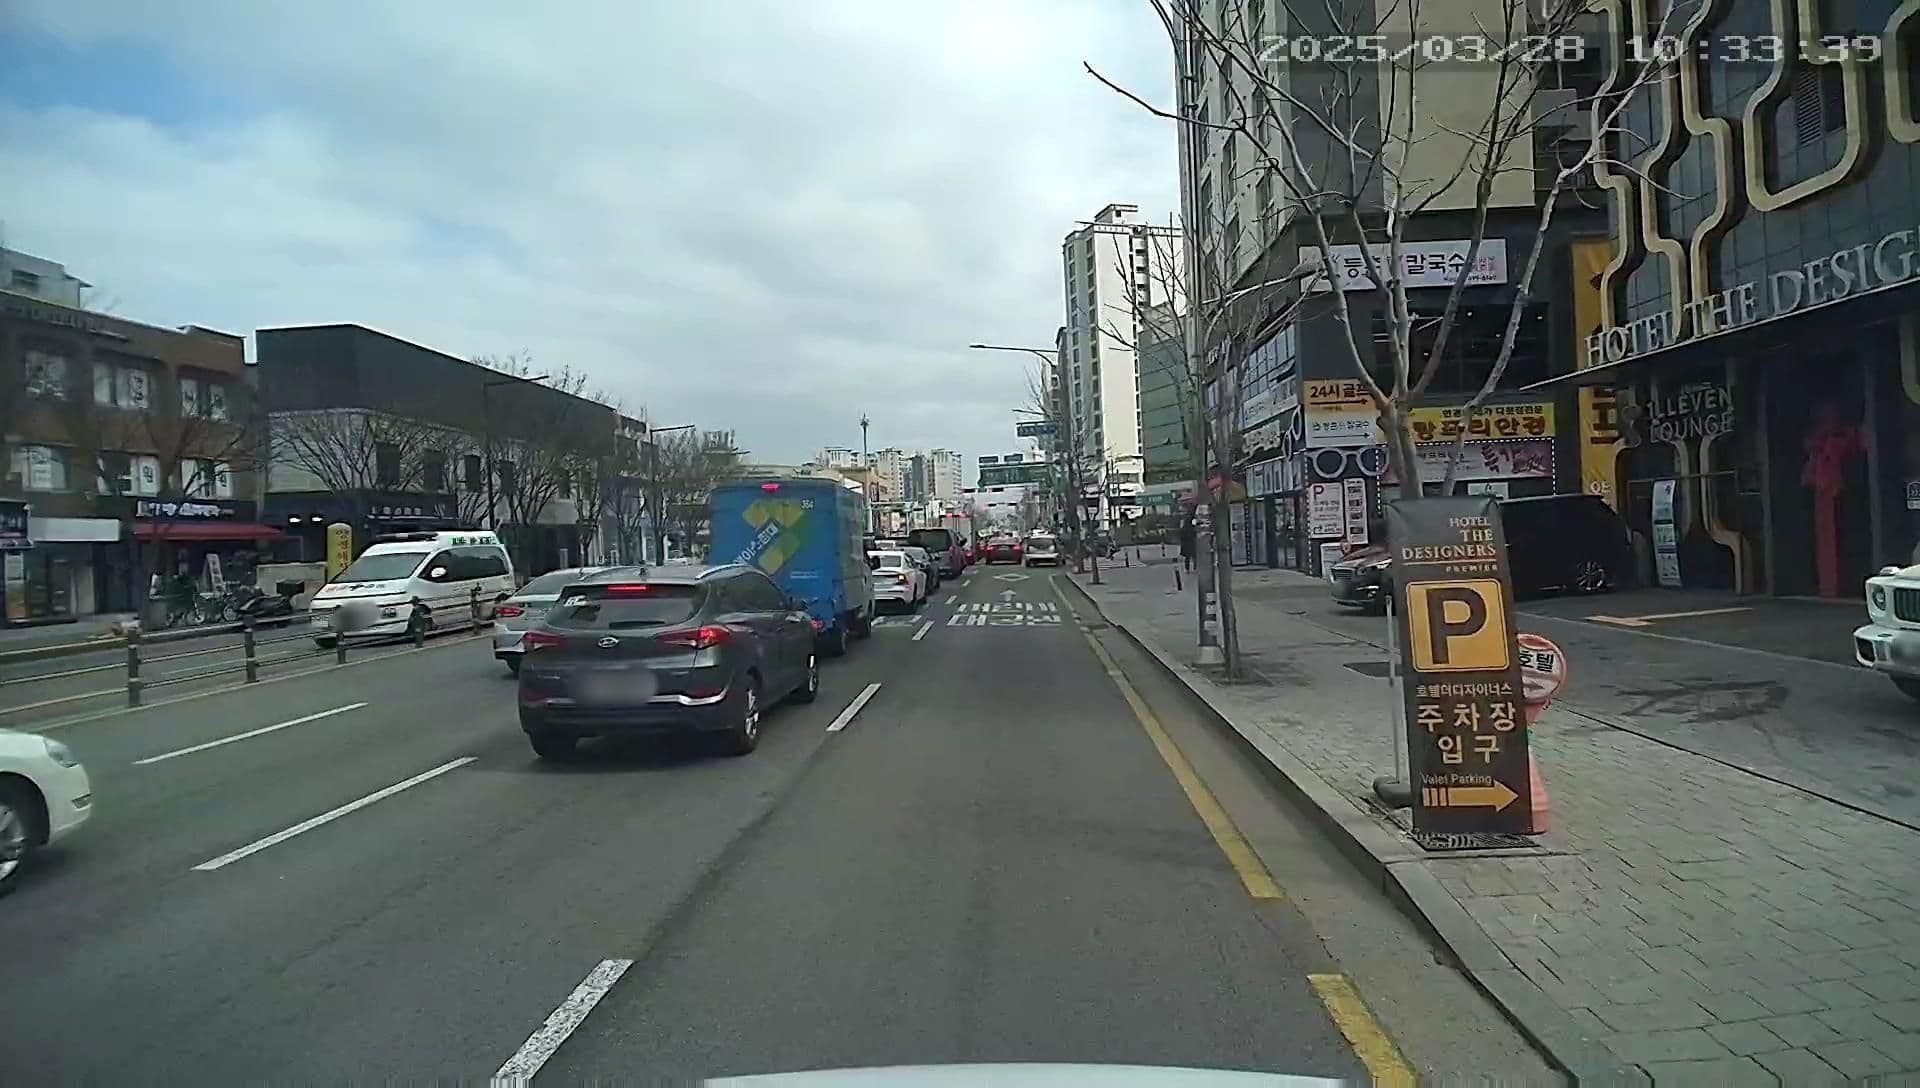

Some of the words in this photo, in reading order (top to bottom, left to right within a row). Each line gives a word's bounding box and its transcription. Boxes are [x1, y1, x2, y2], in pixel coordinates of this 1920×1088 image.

[1585, 310, 1678, 367] HOTEL
[1683, 281, 1759, 337] THE
[1768, 230, 1920, 314] DESIG
[1310, 384, 1339, 399] 24시
[1449, 517, 1491, 528] HOTEL
[1460, 529, 1494, 542] THE
[1402, 543, 1497, 560] DESIGNERS
[1446, 564, 1498, 573] PREMIER
[1426, 587, 1488, 664] P
[1518, 650, 1554, 673] 호텔
[1416, 683, 1513, 698] 호텔더디자이너스
[1437, 735, 1500, 764] 입구
[1421, 774, 1448, 785] Valet
[1451, 774, 1493, 786] Parking
